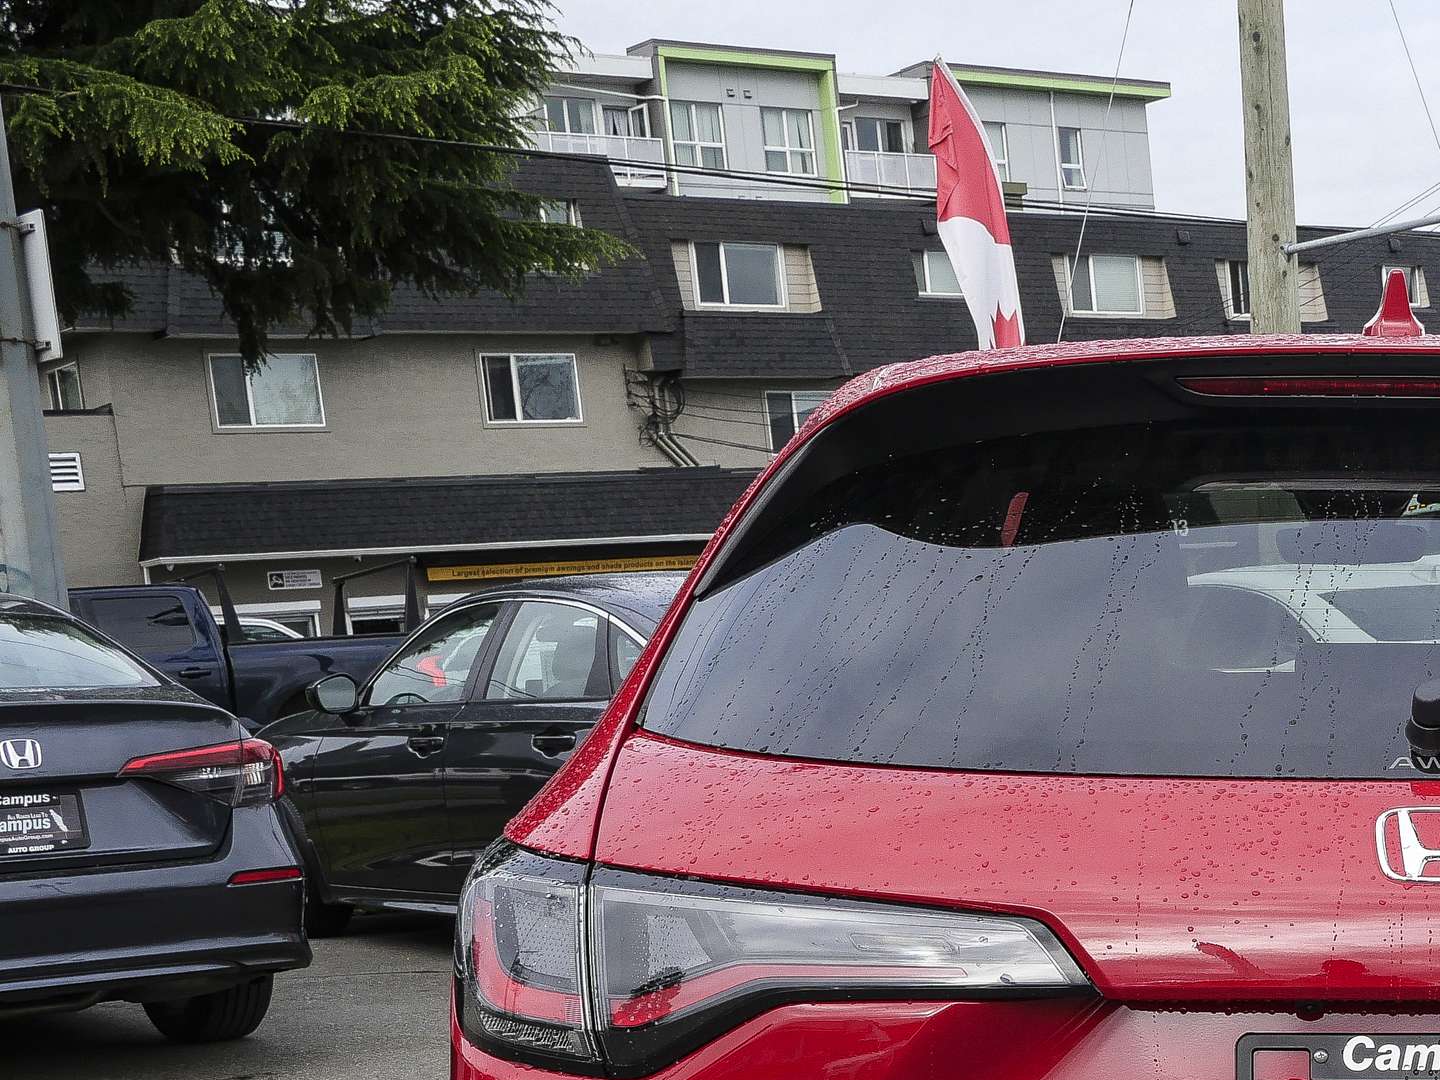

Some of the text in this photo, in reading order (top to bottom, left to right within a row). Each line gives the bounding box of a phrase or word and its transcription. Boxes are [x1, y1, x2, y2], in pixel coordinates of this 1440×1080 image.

[624, 560, 653, 570] products
[8, 844, 55, 854] AUTO GROUP
